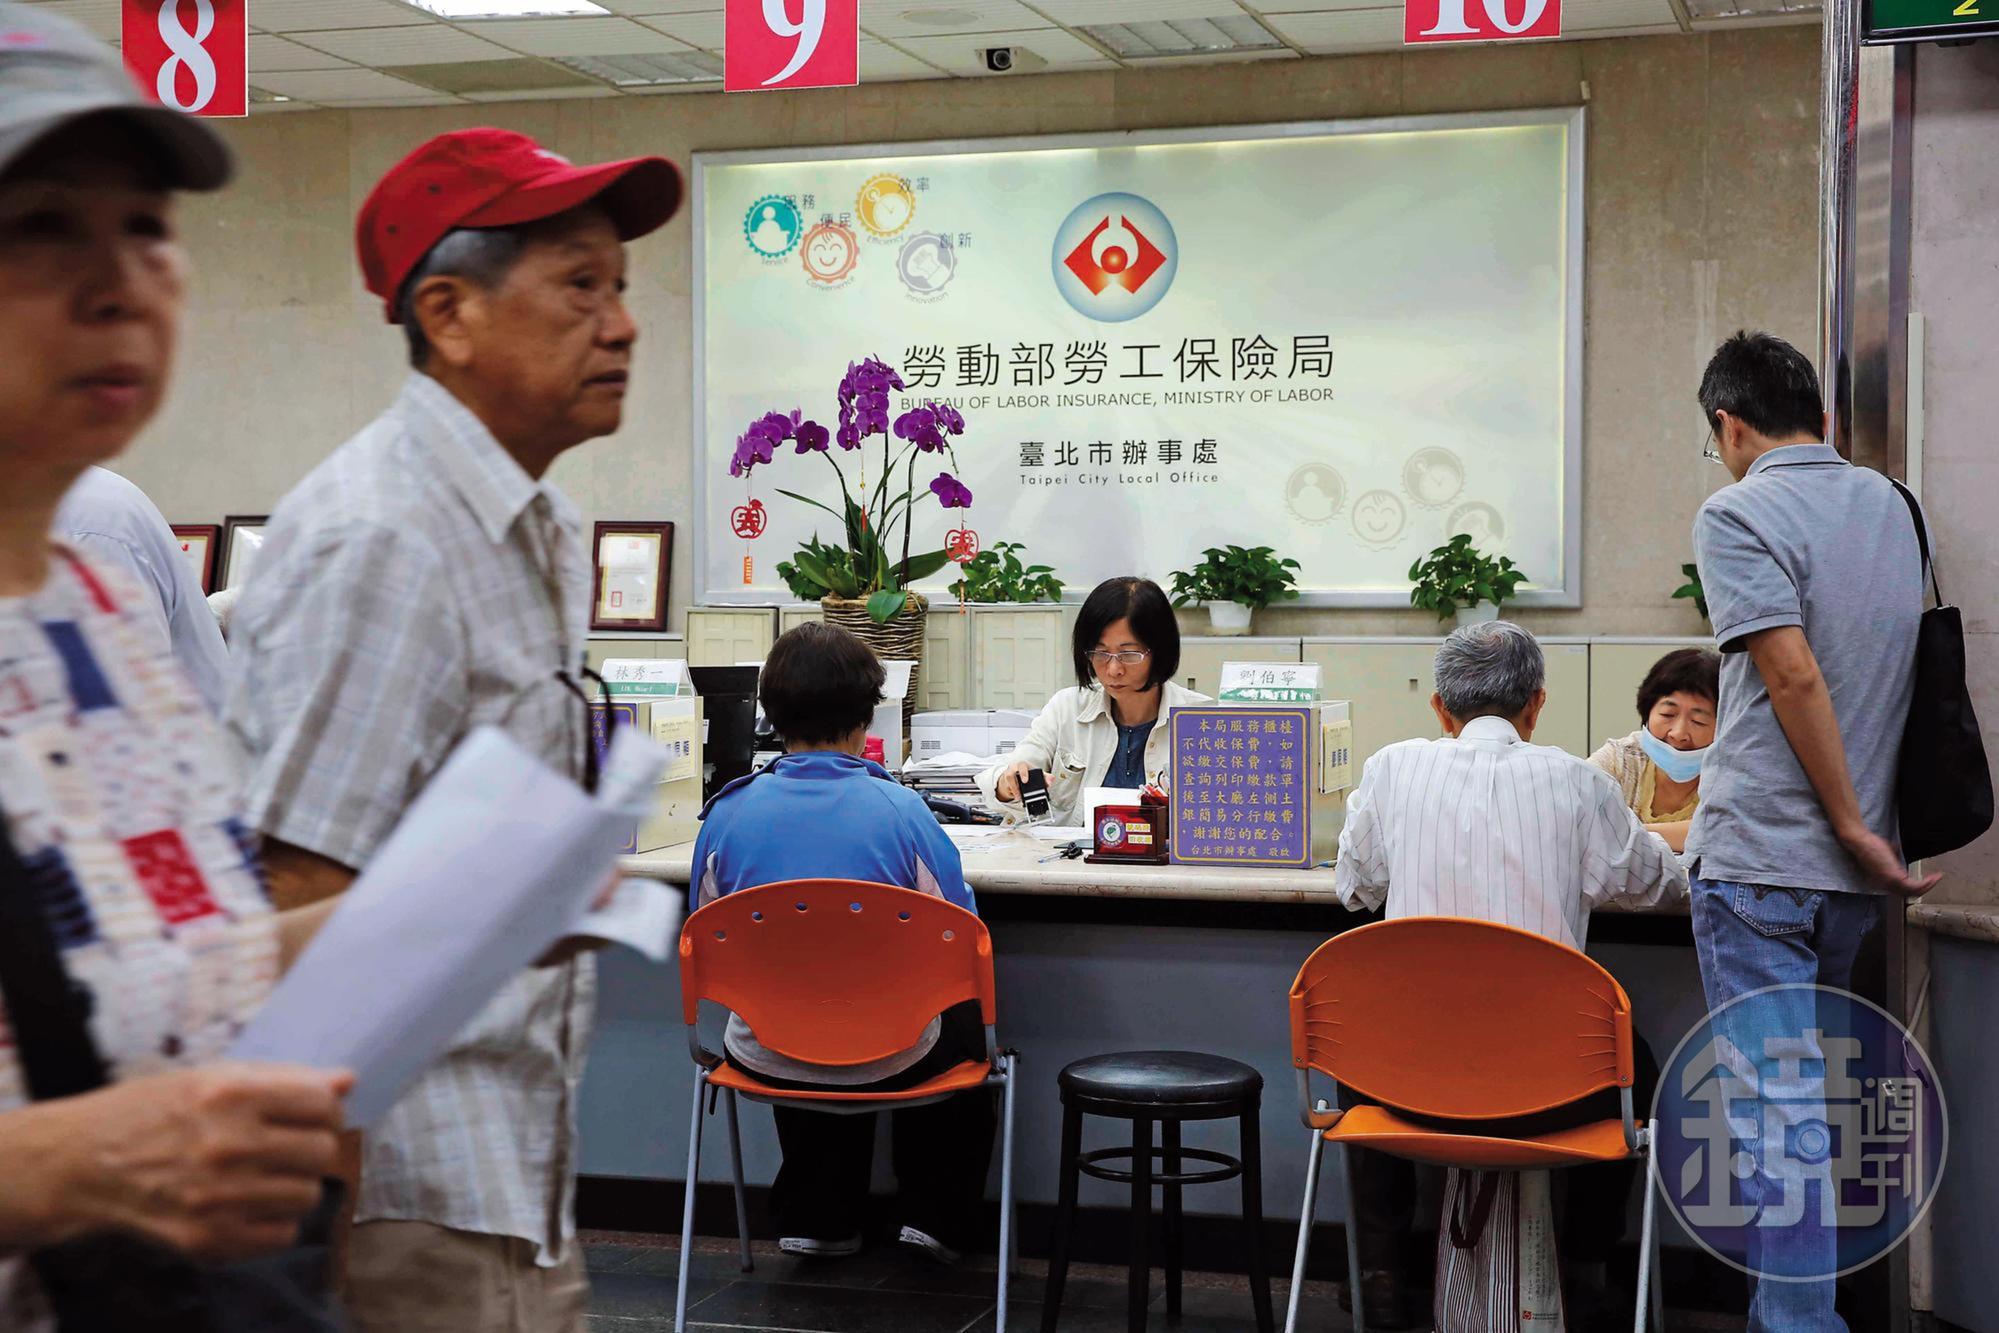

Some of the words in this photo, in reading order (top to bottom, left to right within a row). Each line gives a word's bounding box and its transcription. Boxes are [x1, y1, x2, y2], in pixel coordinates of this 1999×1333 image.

[760, 0, 826, 86] 9
[157, 0, 216, 113] 8
[898, 177, 930, 193] 效率
[784, 194, 816, 211] 服務
[820, 212, 851, 229] 便民
[939, 232, 972, 250] 創新
[903, 334, 1334, 388] 勞動部勞工保險局
[968, 395, 991, 409] OF
[998, 395, 1050, 408] LABOR
[1057, 392, 1157, 407] INSURANCE,
[1164, 390, 1246, 405] MINISTRY
[1249, 389, 1273, 403] OF
[1278, 388, 1334, 402] LABOR
[1019, 438, 1218, 468] 臺北市辦事處
[1020, 474, 1068, 486] Taipei
[1078, 473, 1108, 486] City
[1119, 472, 1159, 484] Local
[1170, 471, 1218, 483] Office
